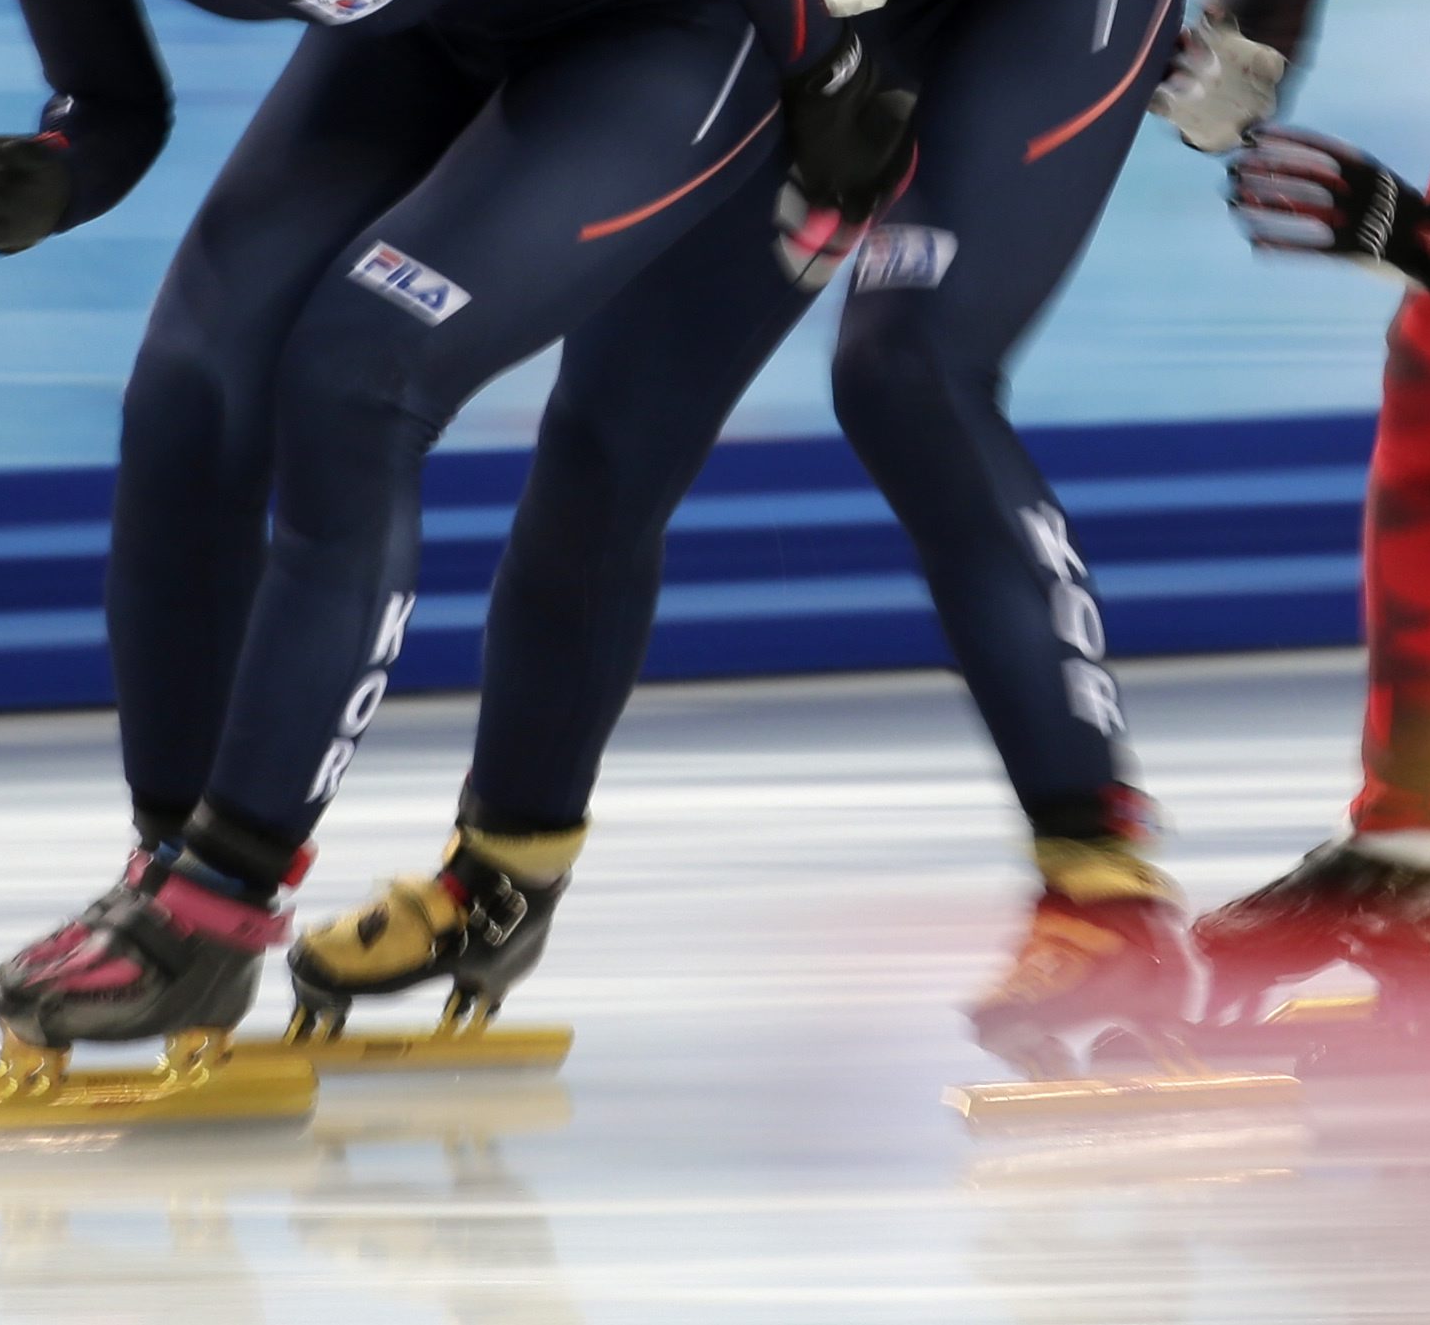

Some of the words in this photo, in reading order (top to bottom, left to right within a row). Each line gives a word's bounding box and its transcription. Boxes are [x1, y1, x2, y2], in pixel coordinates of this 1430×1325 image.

[363, 248, 451, 312] FILA
[304, 590, 417, 804] KOR
[1016, 500, 1128, 737] KOR
